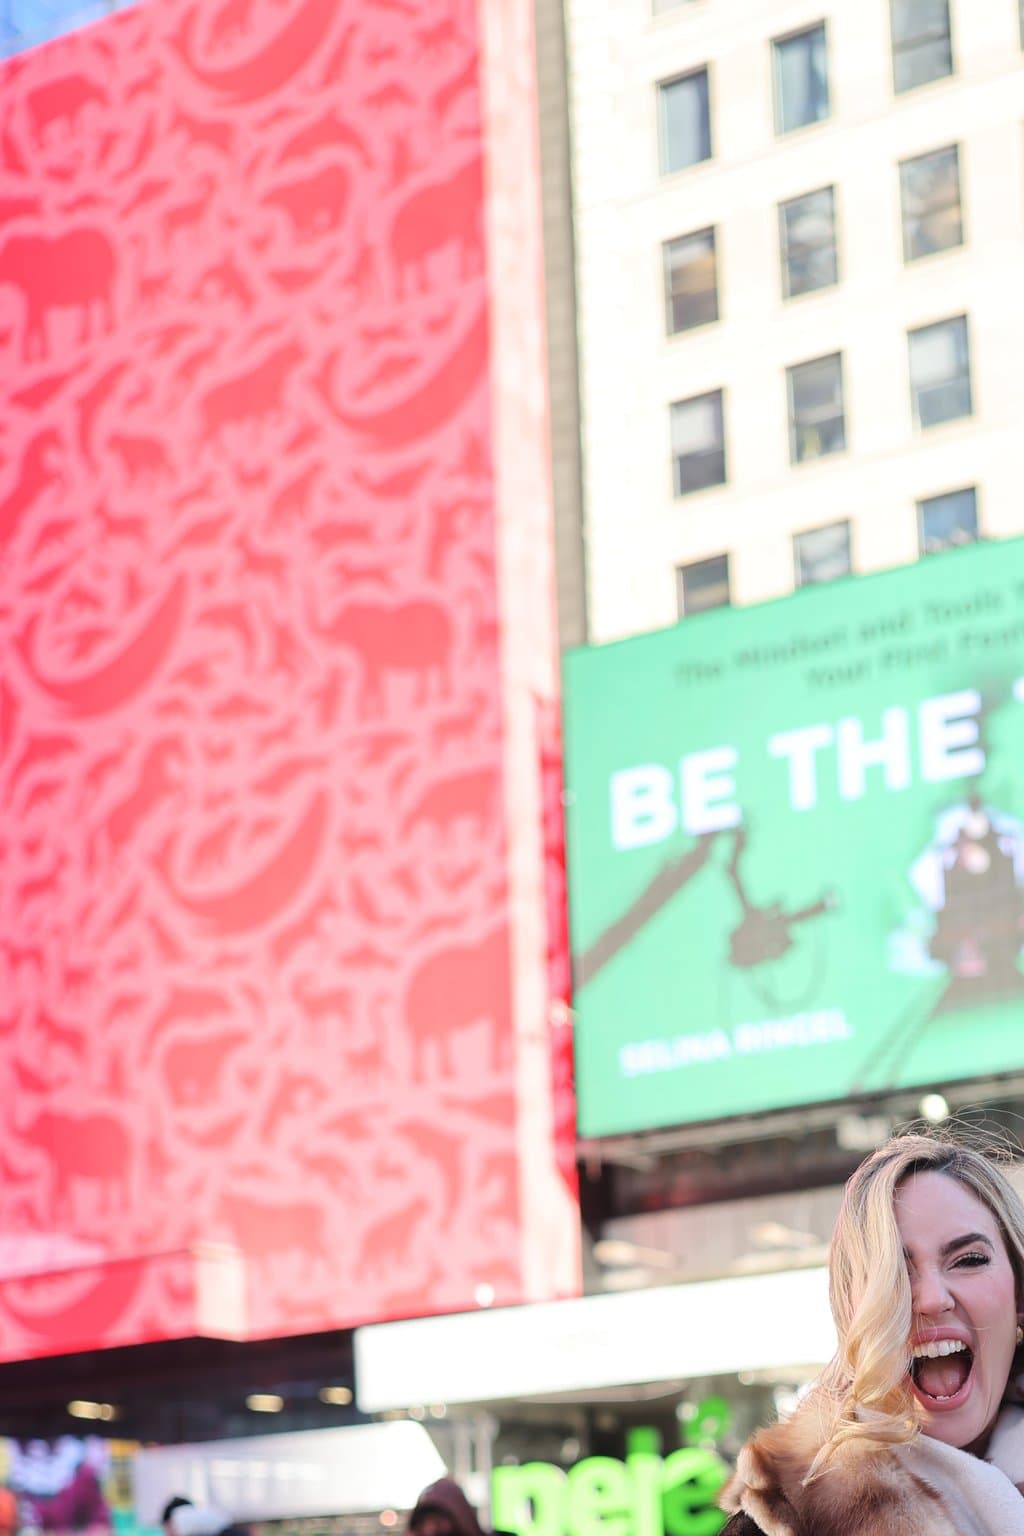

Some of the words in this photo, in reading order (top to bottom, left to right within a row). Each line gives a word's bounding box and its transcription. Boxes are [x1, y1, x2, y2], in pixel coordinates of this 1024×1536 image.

[732, 624, 849, 669] Mindset
[858, 611, 914, 642] and
[922, 590, 1004, 623] Tools
[805, 661, 872, 689] Your
[880, 637, 949, 671] First
[608, 744, 744, 852] BE
[767, 690, 988, 811] THE
